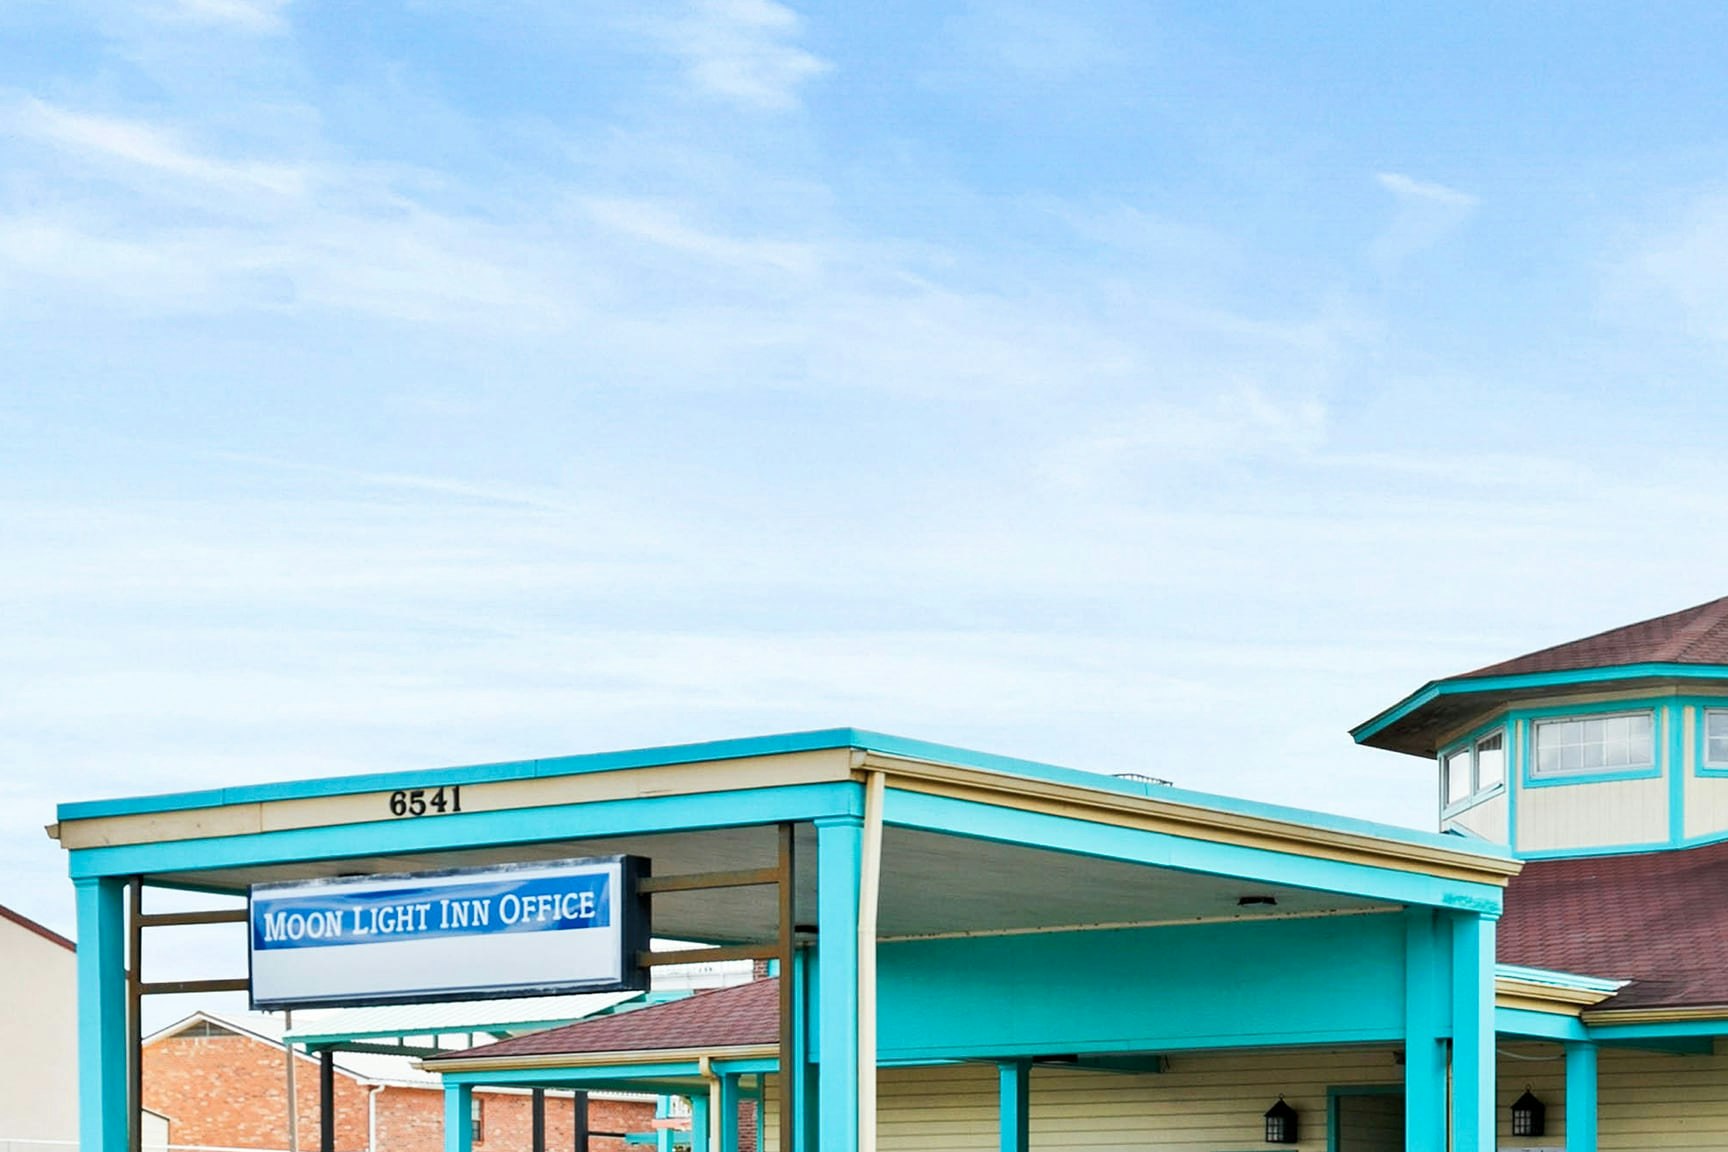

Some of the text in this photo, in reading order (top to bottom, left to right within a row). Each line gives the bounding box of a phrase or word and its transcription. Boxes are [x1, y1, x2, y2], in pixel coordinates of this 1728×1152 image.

[390, 786, 462, 815] 6541
[263, 891, 596, 942] MOON LIGHT INN OFFICE
